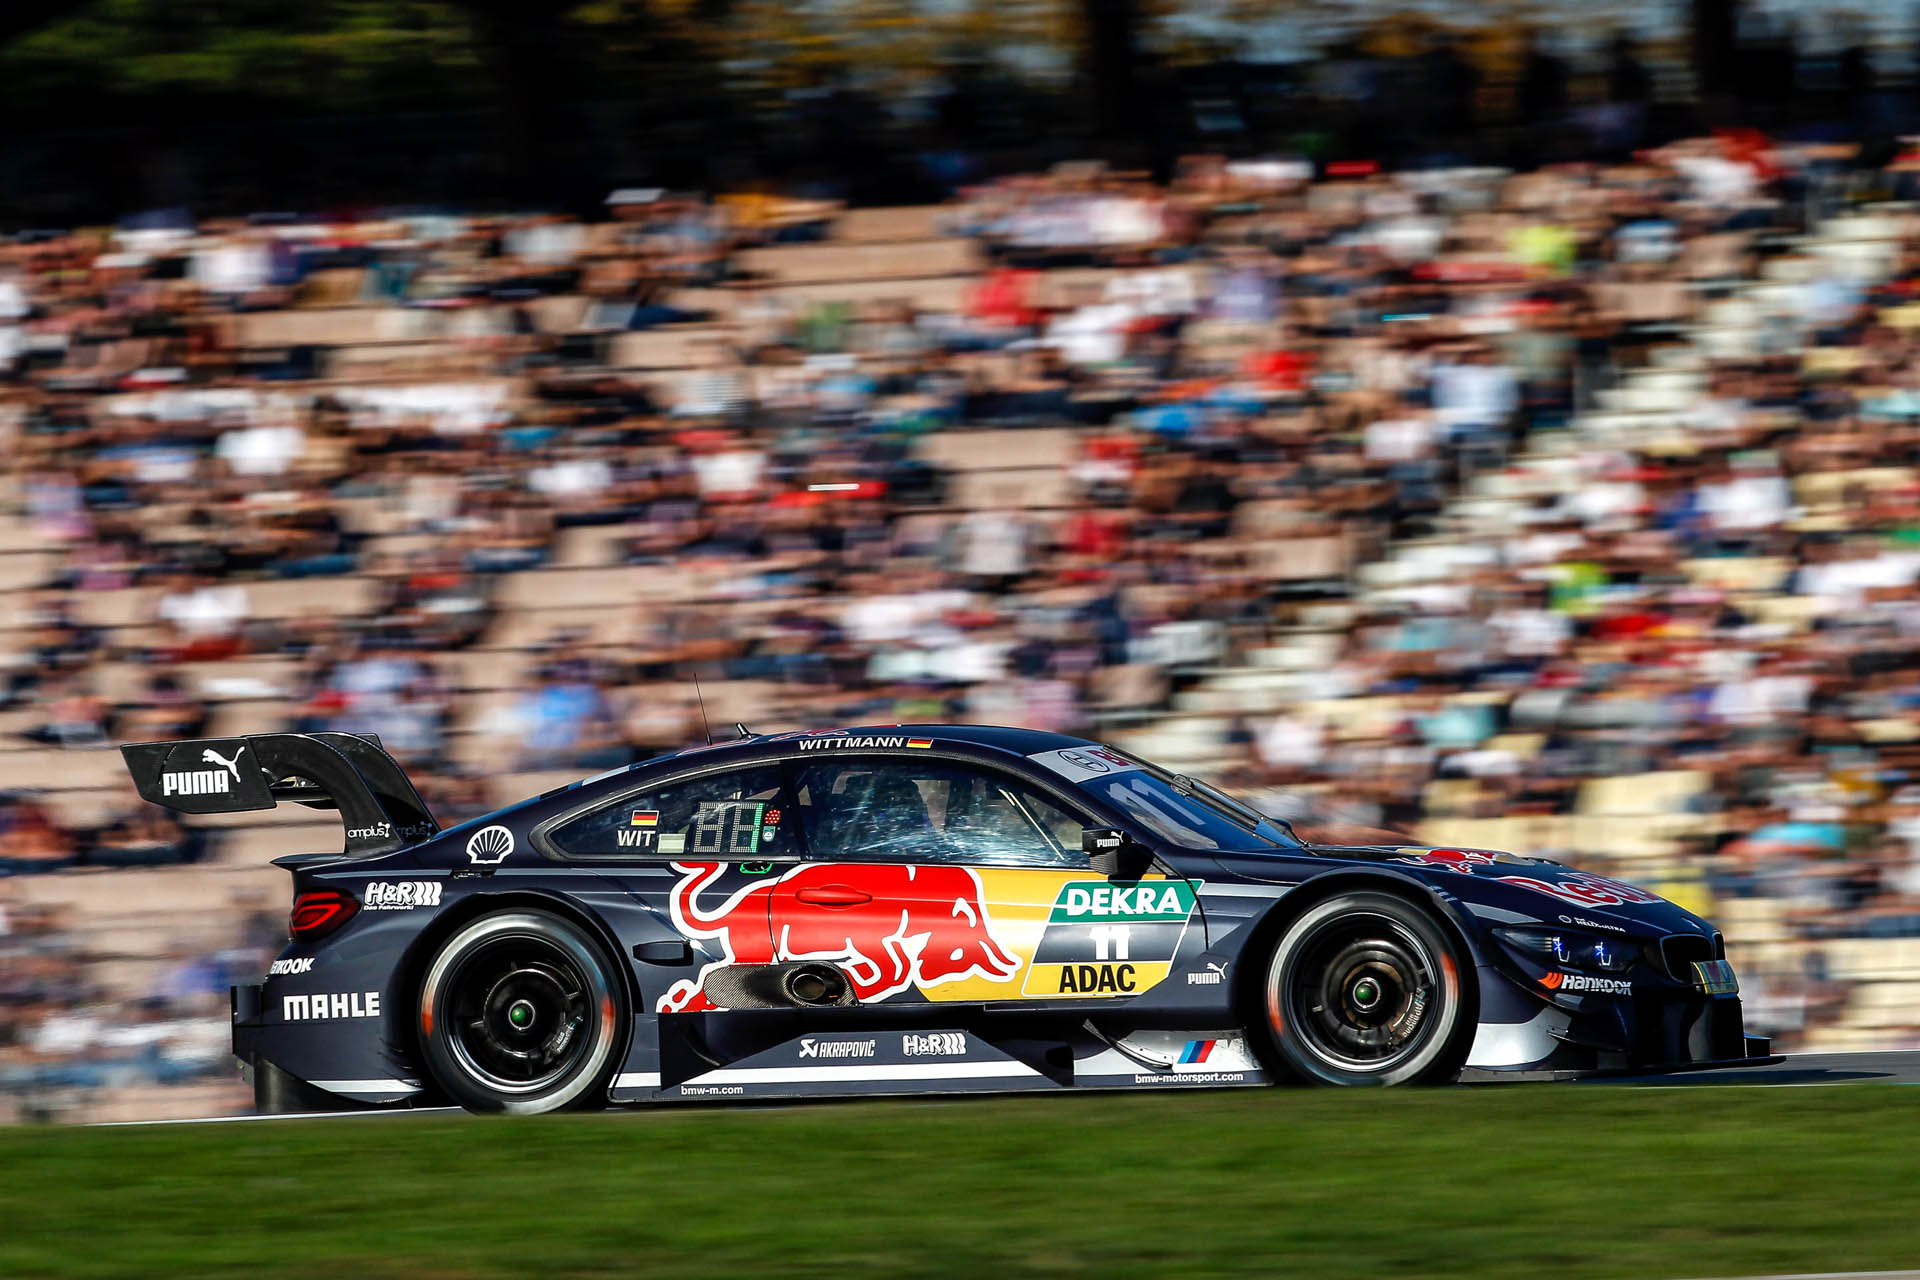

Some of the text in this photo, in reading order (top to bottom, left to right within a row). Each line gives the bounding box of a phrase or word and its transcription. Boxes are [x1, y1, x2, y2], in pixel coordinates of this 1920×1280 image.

[799, 737, 904, 750] WITTMANN
[162, 769, 229, 796] PUMA
[616, 829, 656, 847] WIT
[1096, 838, 1120, 848] PUMA
[365, 881, 418, 905] H&R
[1066, 886, 1183, 916] DEKRA
[1089, 925, 1131, 960] 11
[1058, 963, 1137, 993] ADAC
[1187, 971, 1221, 985] PUMA
[283, 992, 381, 1021] MAHLE
[902, 1034, 946, 1056] H&R
[1135, 1073, 1244, 1084] bmw-motorsport.com
[680, 1085, 744, 1095] bmw-m.com
